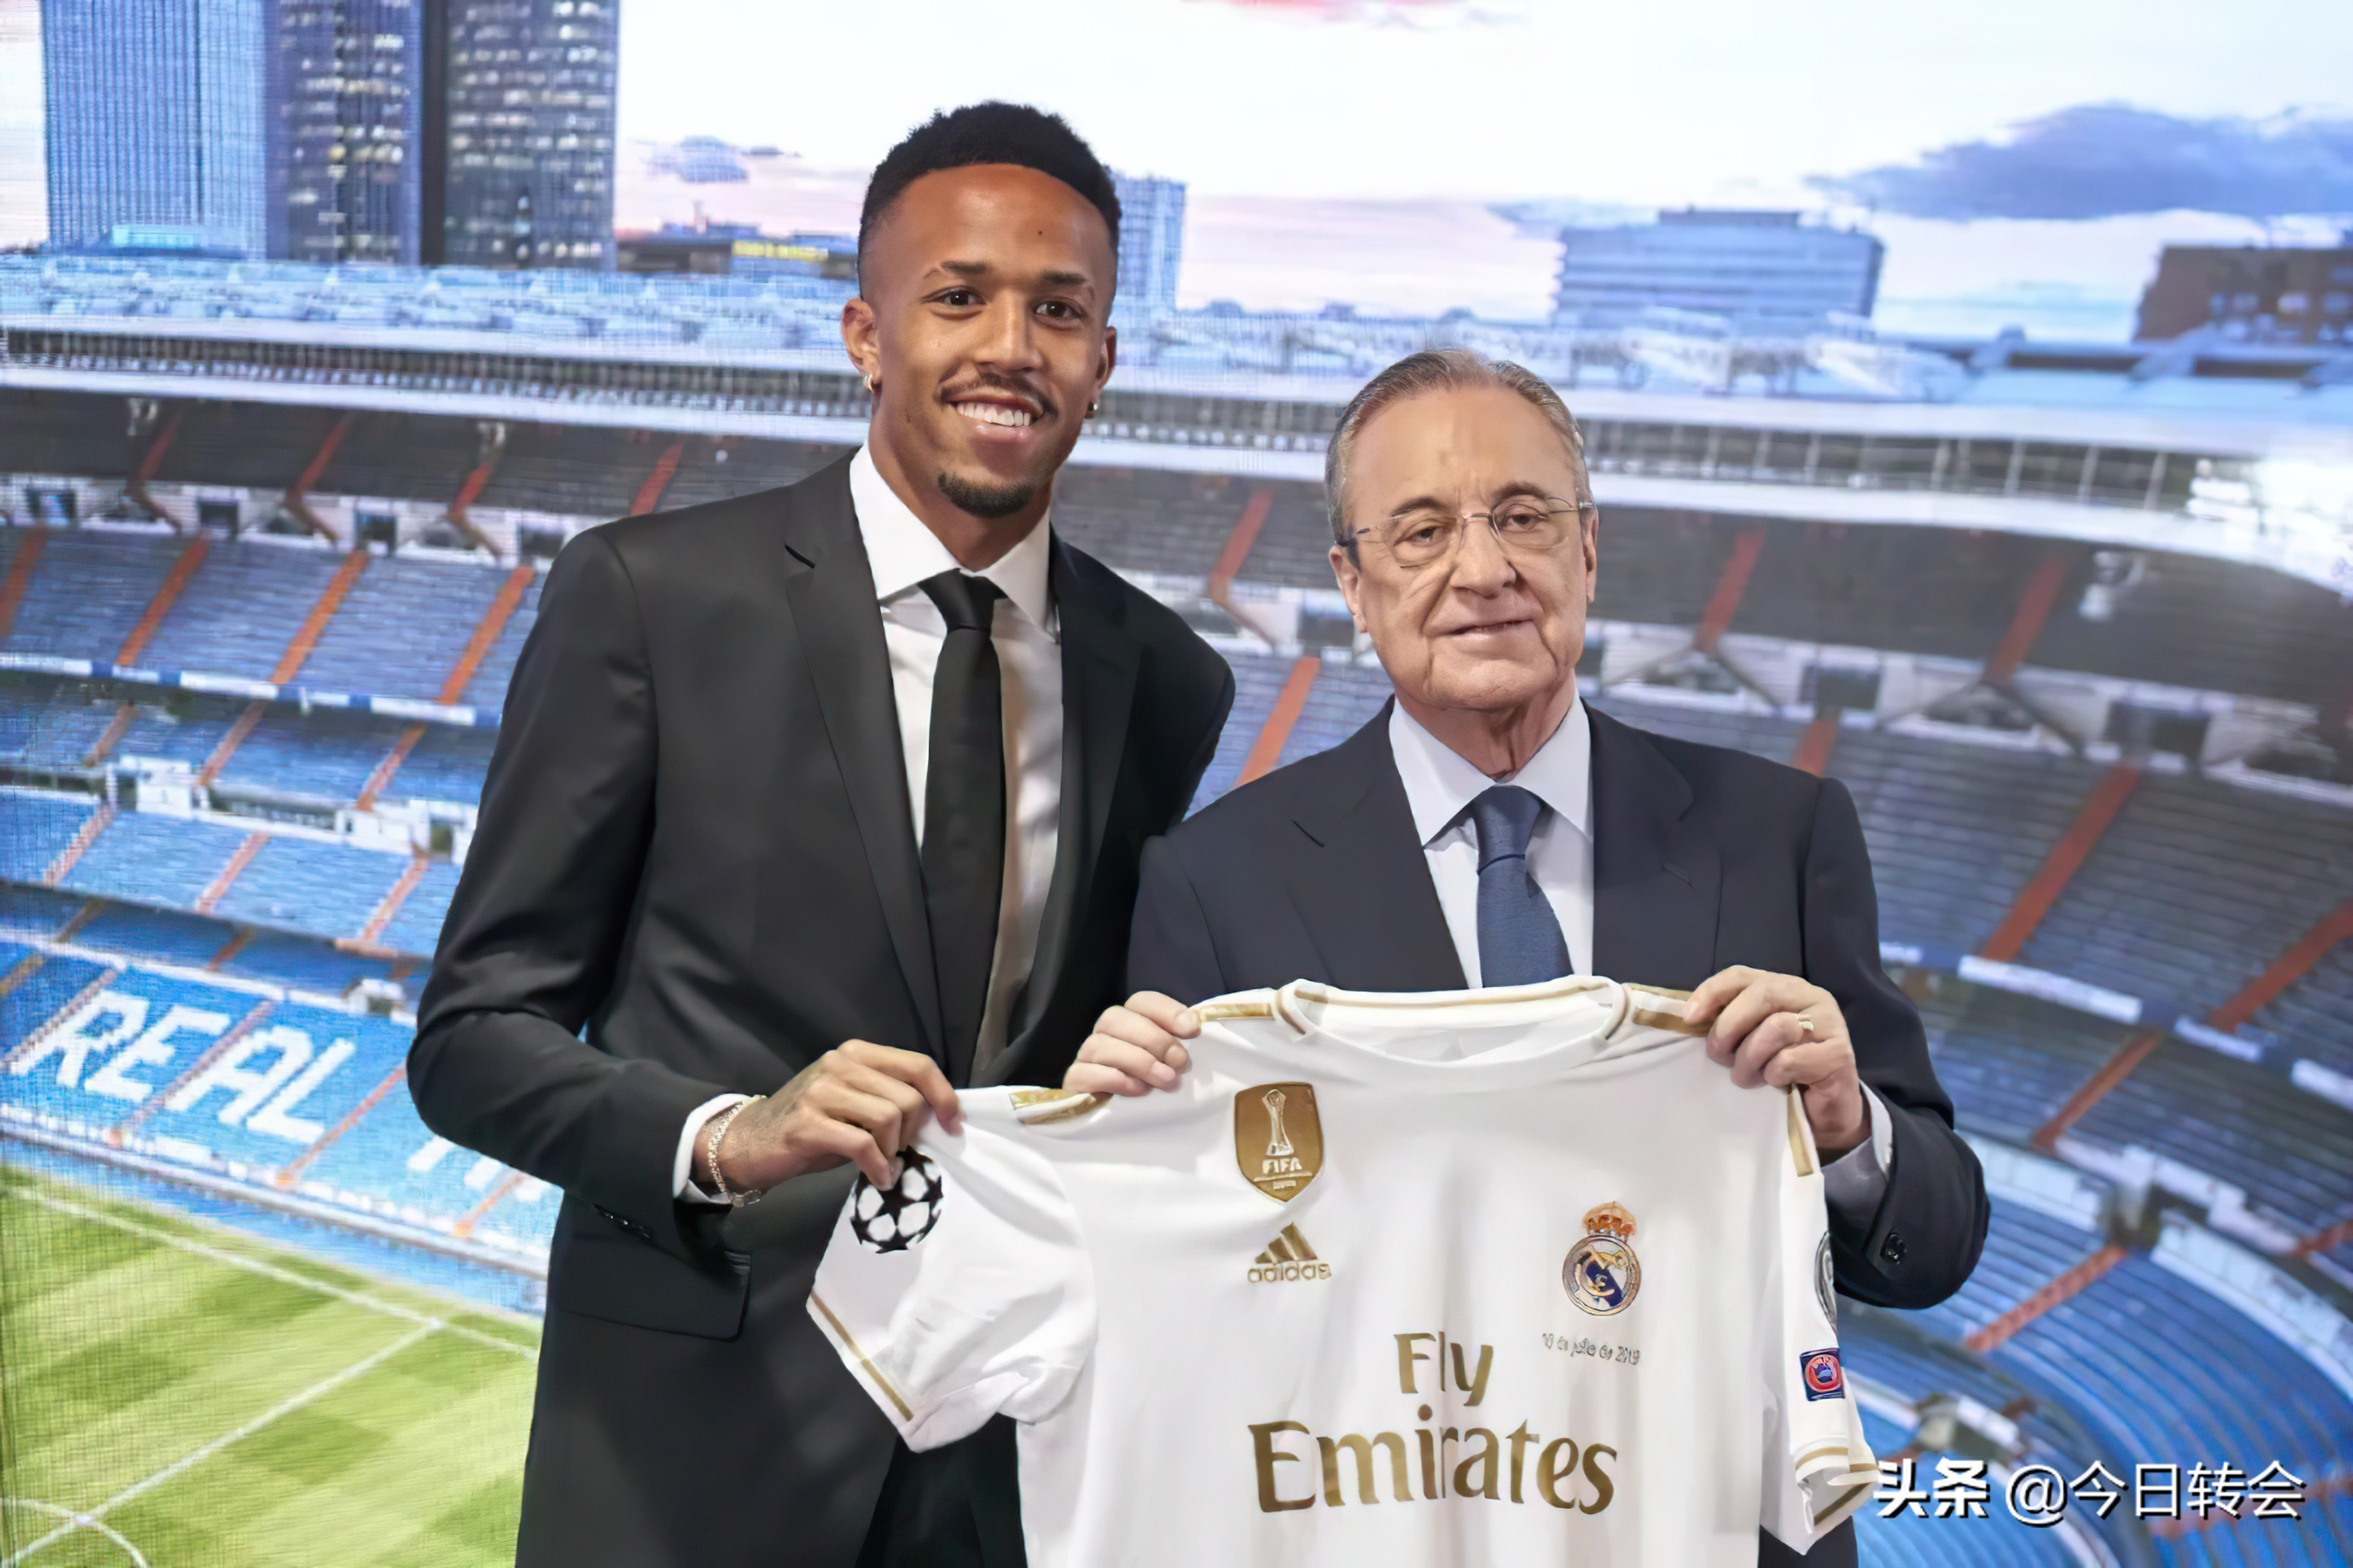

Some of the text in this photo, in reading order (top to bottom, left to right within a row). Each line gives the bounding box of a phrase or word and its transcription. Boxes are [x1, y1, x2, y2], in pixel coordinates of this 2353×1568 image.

[8, 989, 356, 1145] REAL
[1262, 1157, 1303, 1175] FIFA
[1247, 1261, 1332, 1283] adidas
[1393, 1331, 1494, 1407] Fly
[1247, 1404, 1618, 1515] Emirates
